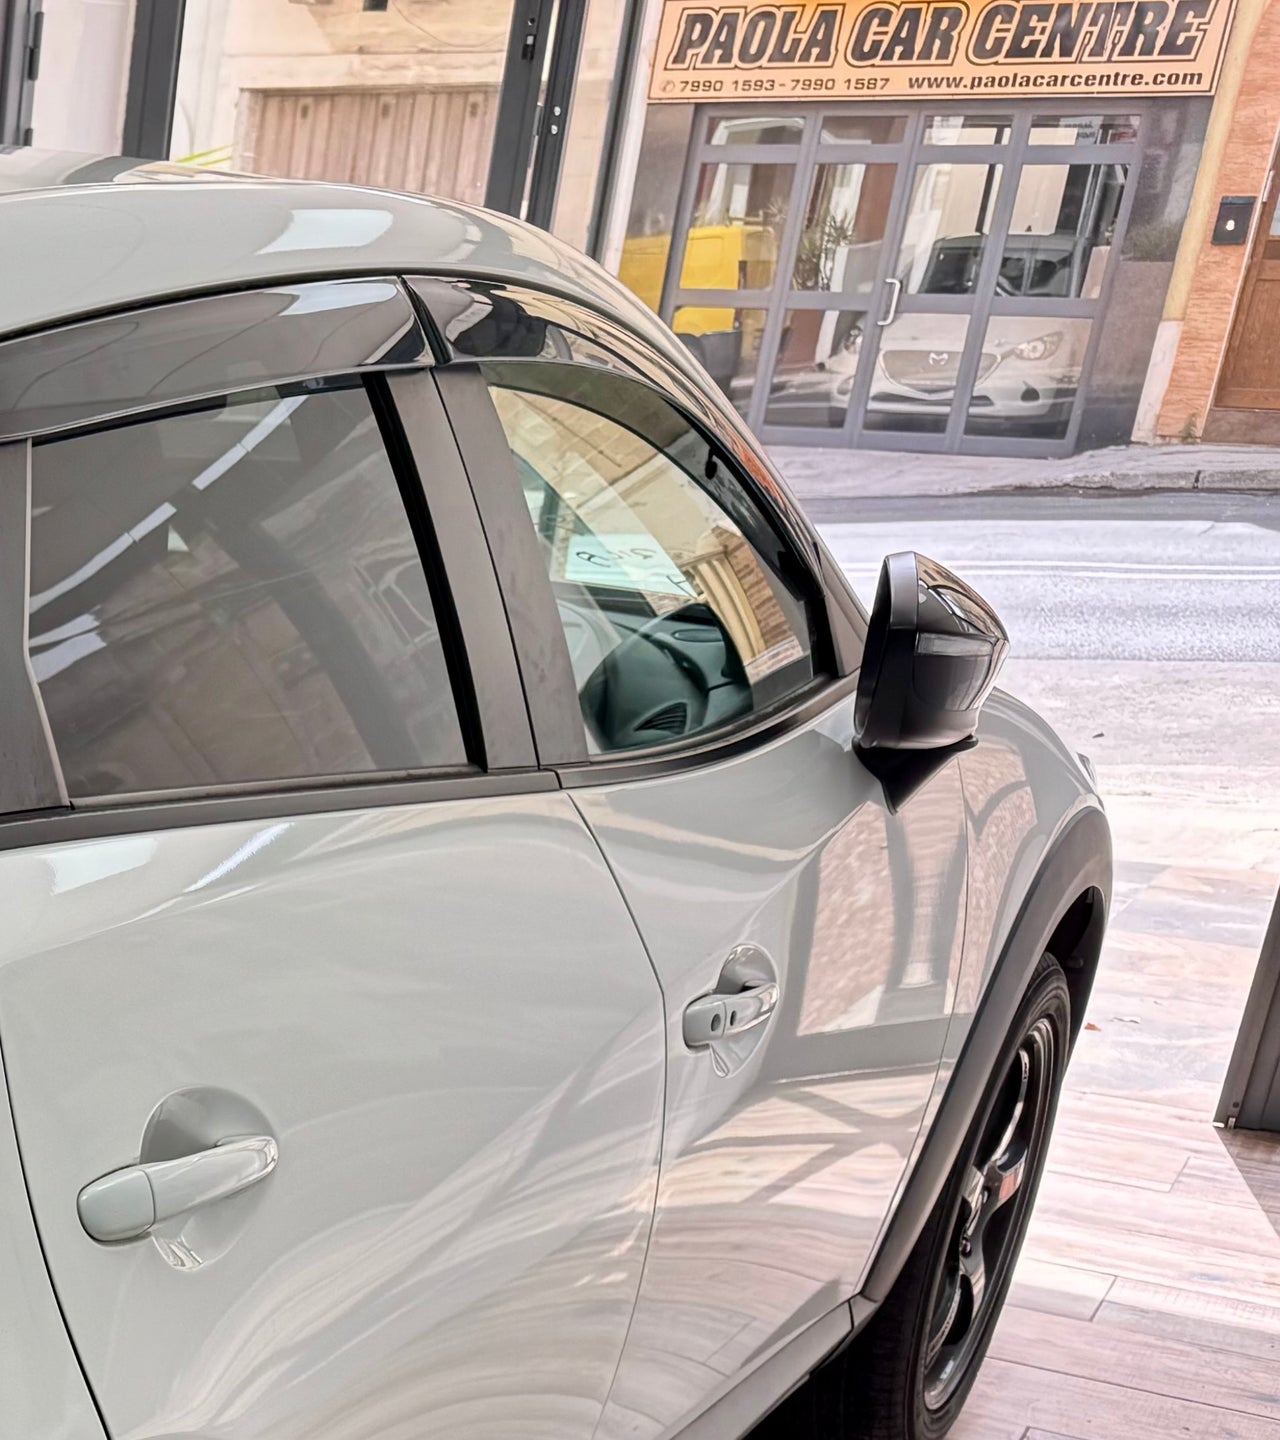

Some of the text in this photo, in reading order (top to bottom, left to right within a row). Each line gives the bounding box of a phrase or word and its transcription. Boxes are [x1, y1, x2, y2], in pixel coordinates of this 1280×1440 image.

[667, 0, 1212, 69] PAOLA CAR CENTRE
[679, 79, 724, 93] 7990
[843, 77, 890, 91] 1587
[907, 71, 1203, 91] www.paolacarcentre.com
